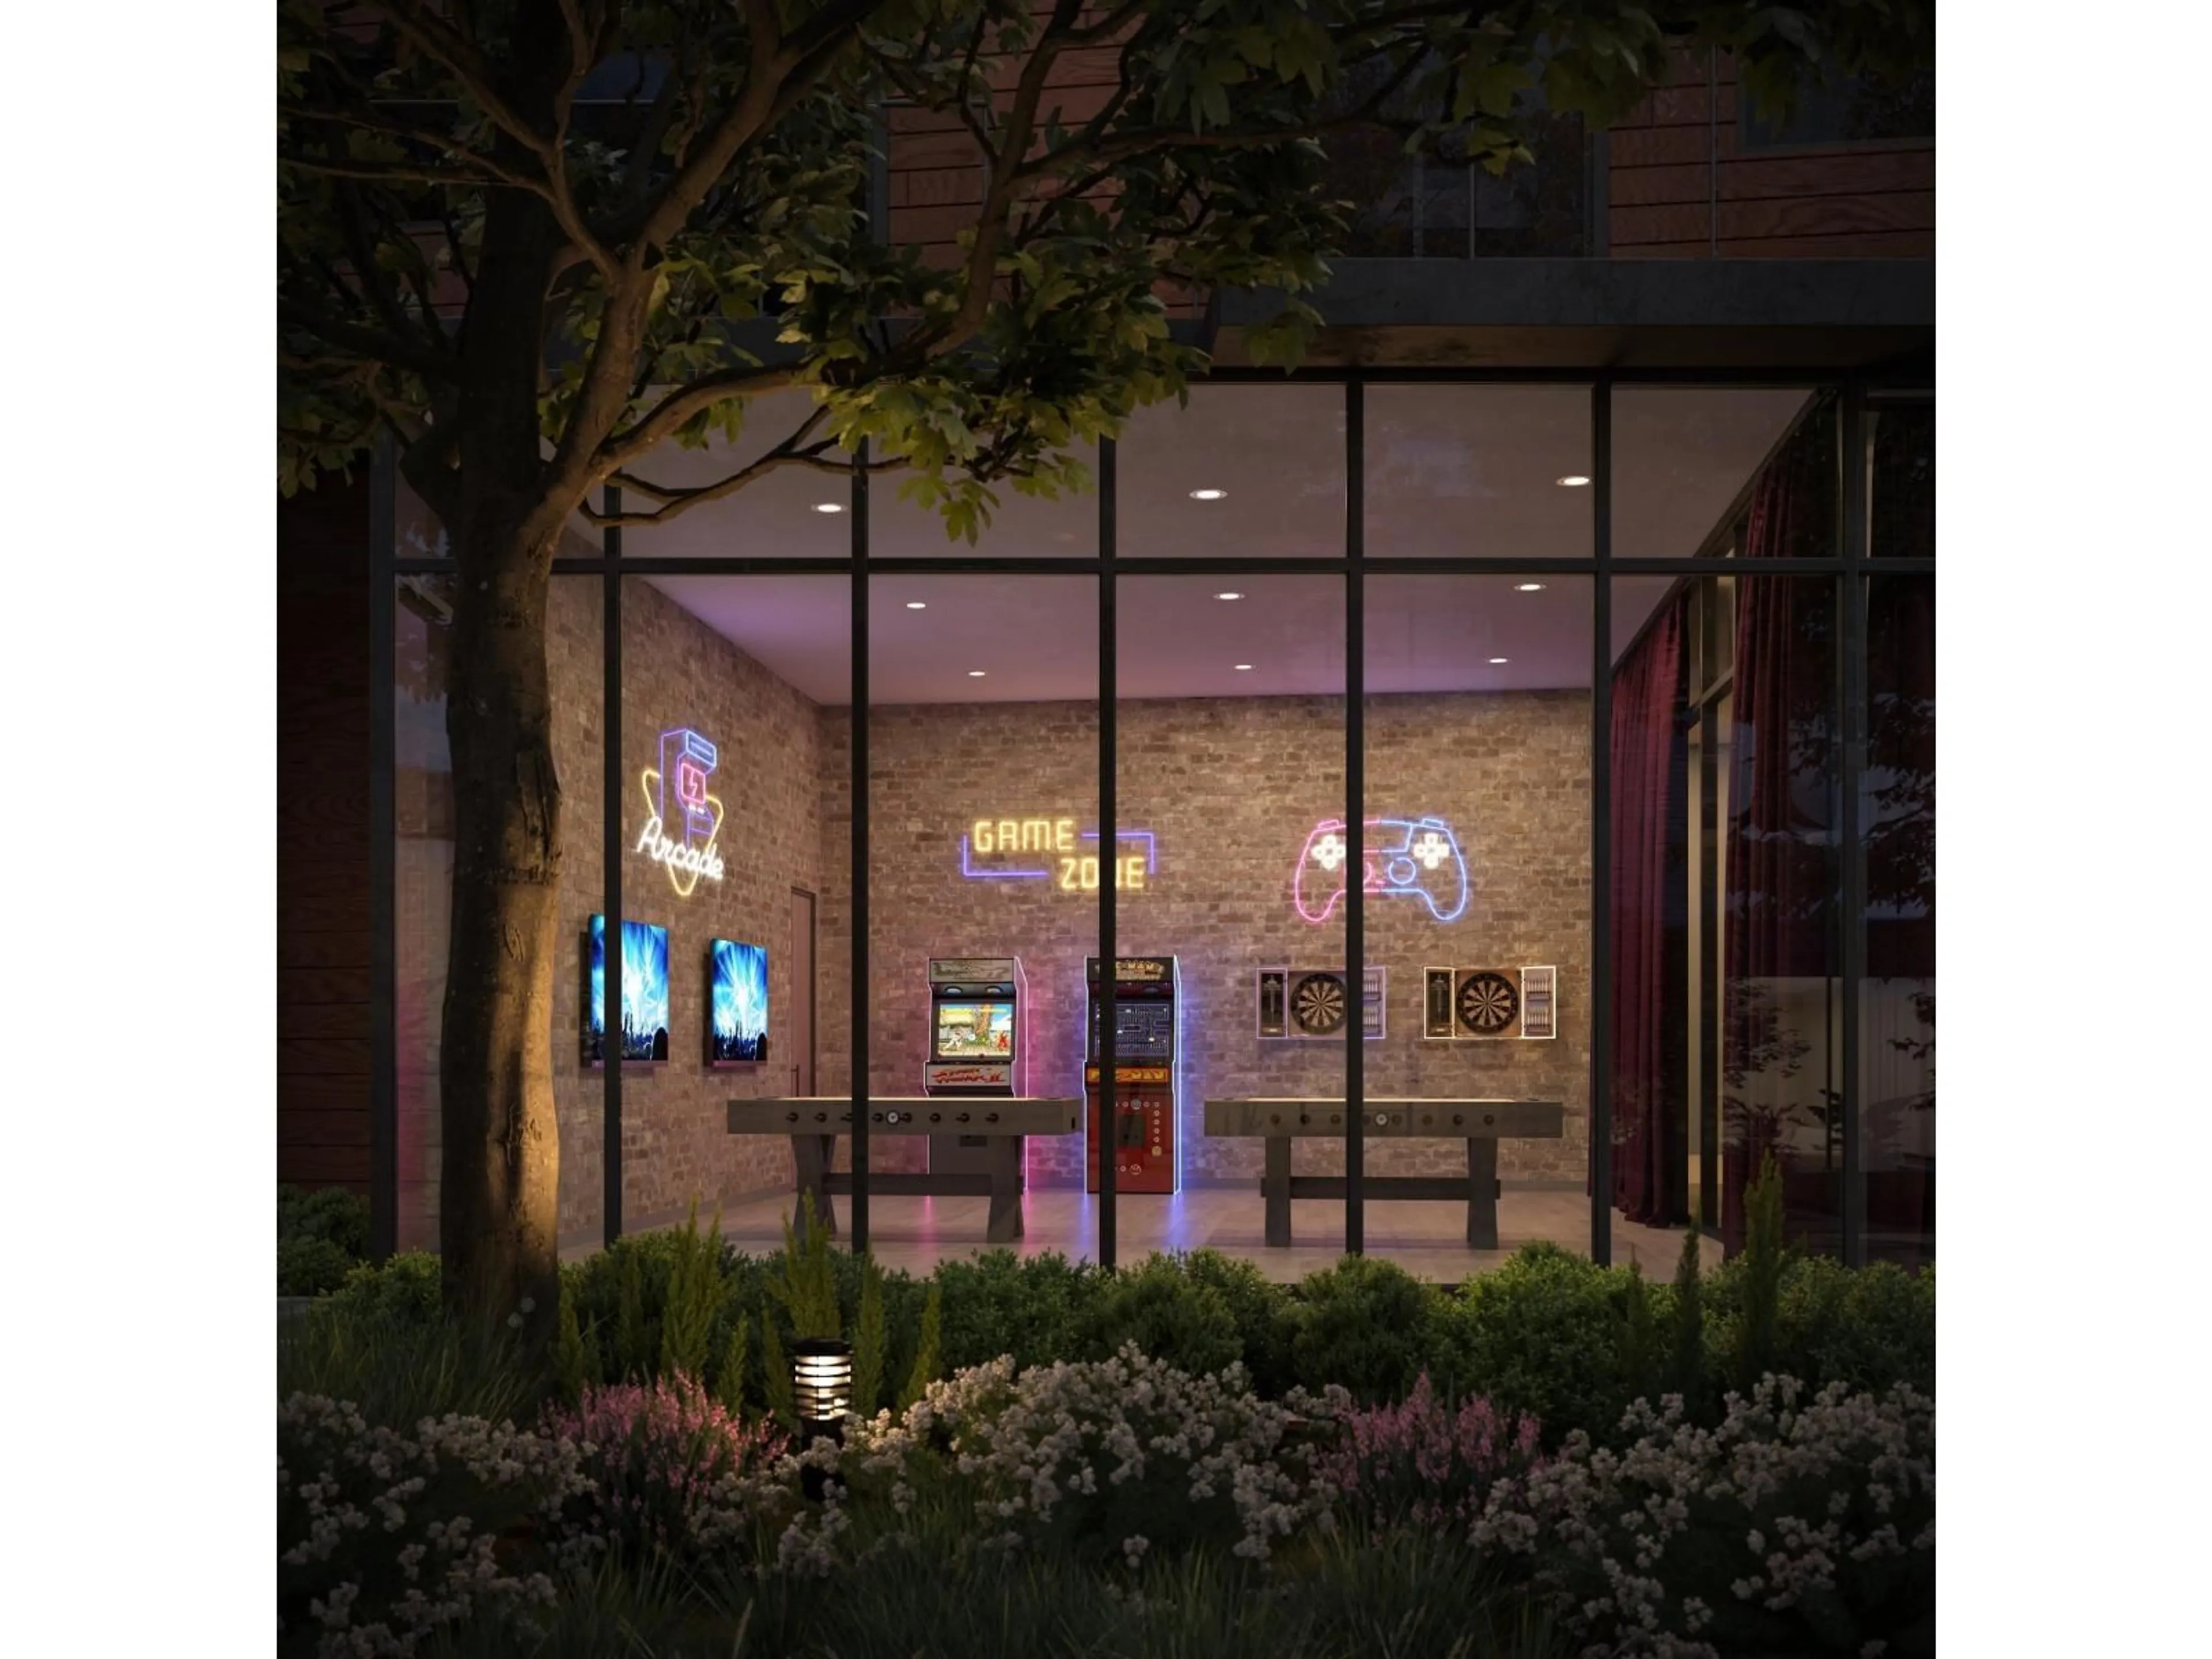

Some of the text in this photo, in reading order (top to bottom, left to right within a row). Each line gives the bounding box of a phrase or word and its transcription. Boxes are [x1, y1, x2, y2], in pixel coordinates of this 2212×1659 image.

[635, 815, 724, 880] Arcade
[974, 820, 1074, 851] GAME
[1060, 857, 1145, 889] ZOE
